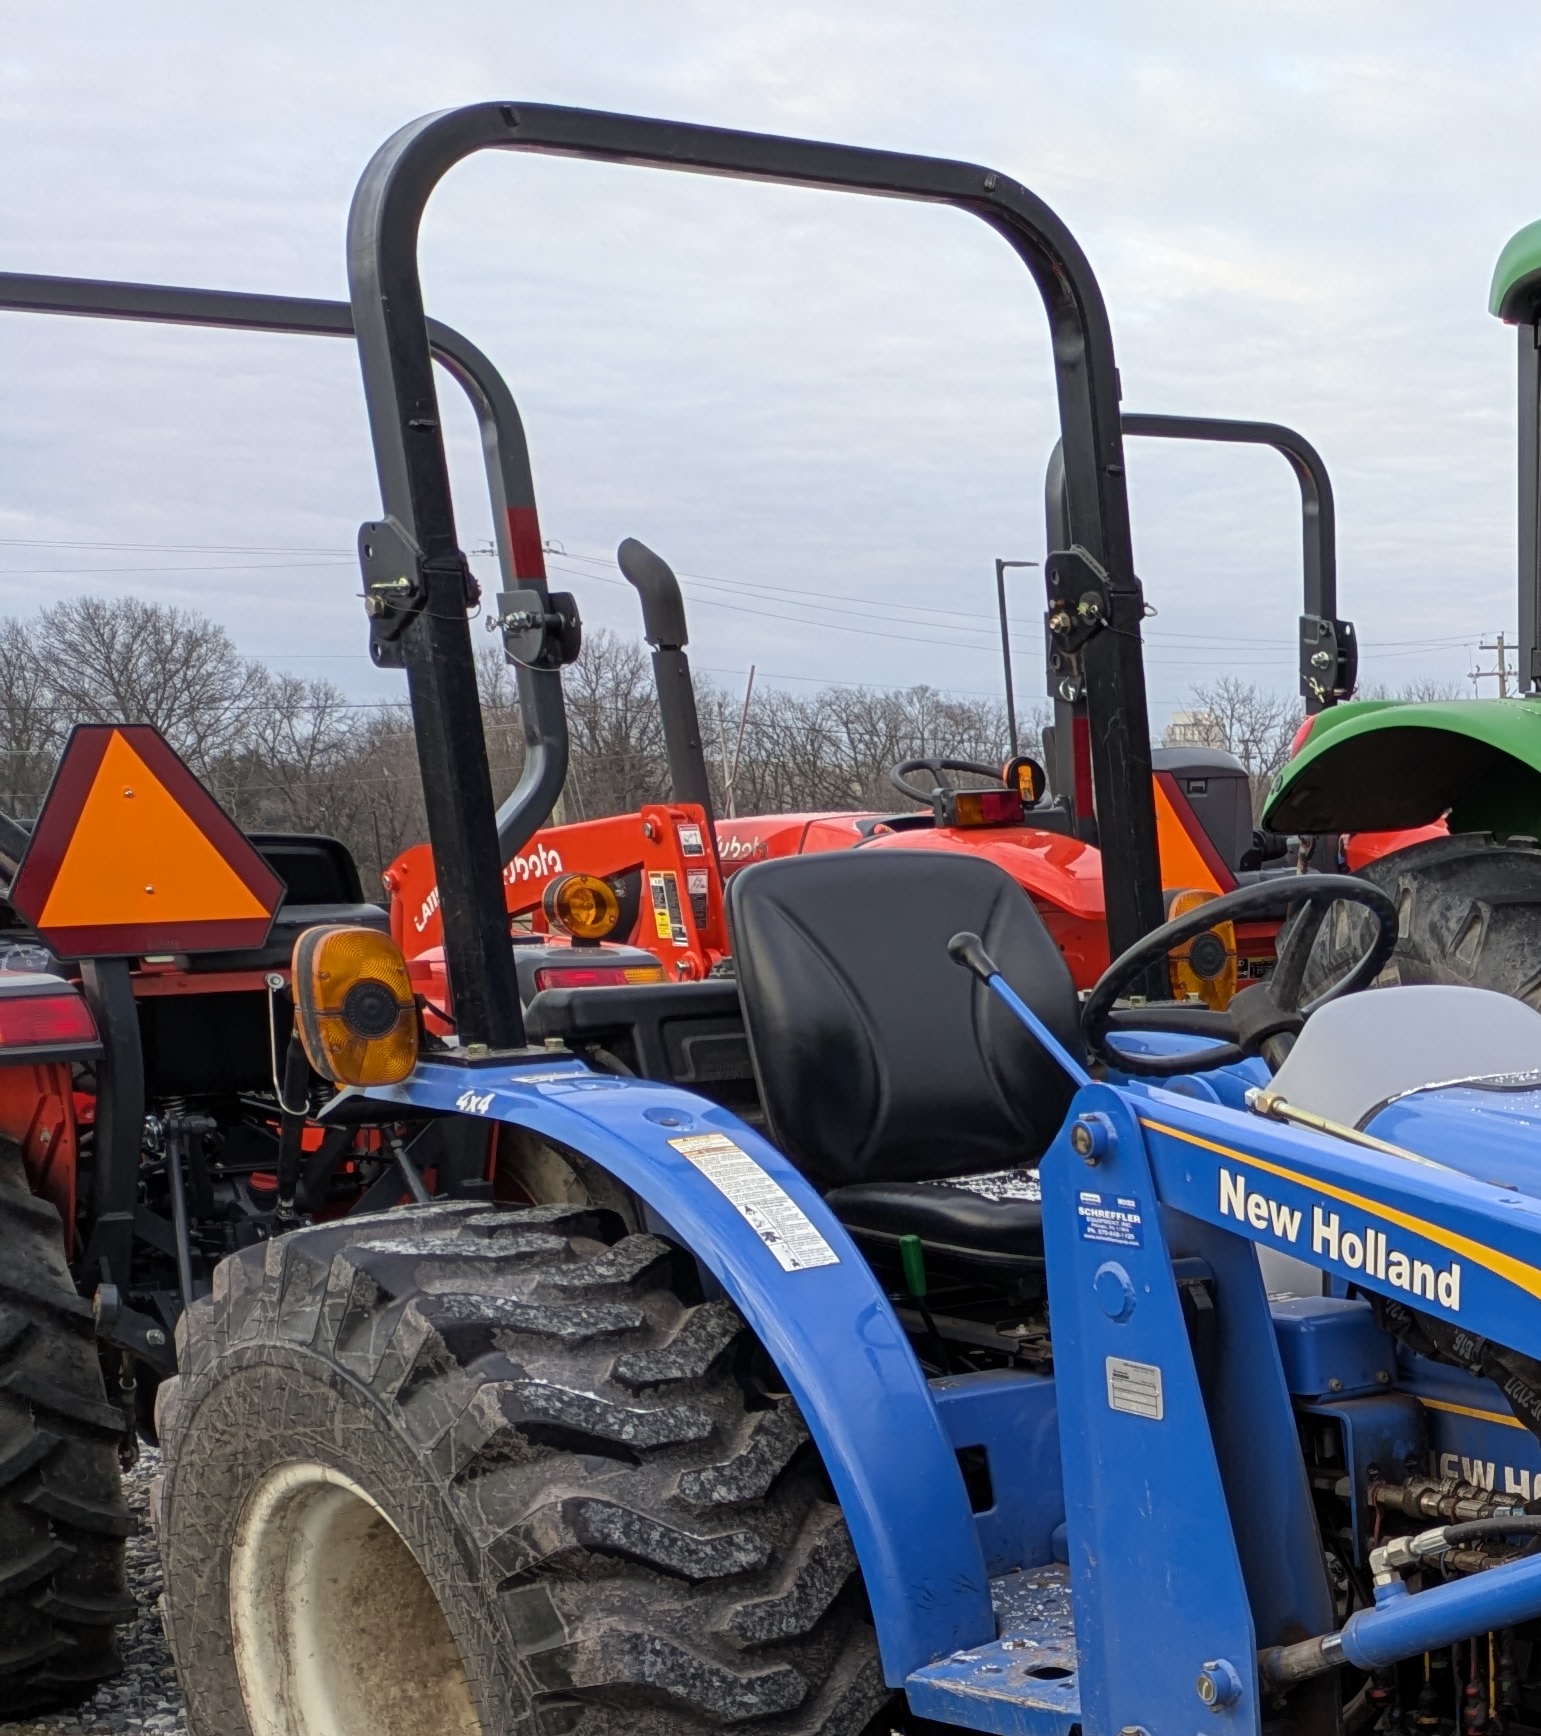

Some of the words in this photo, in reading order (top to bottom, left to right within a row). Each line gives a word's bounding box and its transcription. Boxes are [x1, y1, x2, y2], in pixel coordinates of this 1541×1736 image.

[503, 843, 563, 886] ubota
[456, 1090, 496, 1115] 4x4
[1218, 1166, 1303, 1244] New
[1311, 1204, 1462, 1313] Holland
